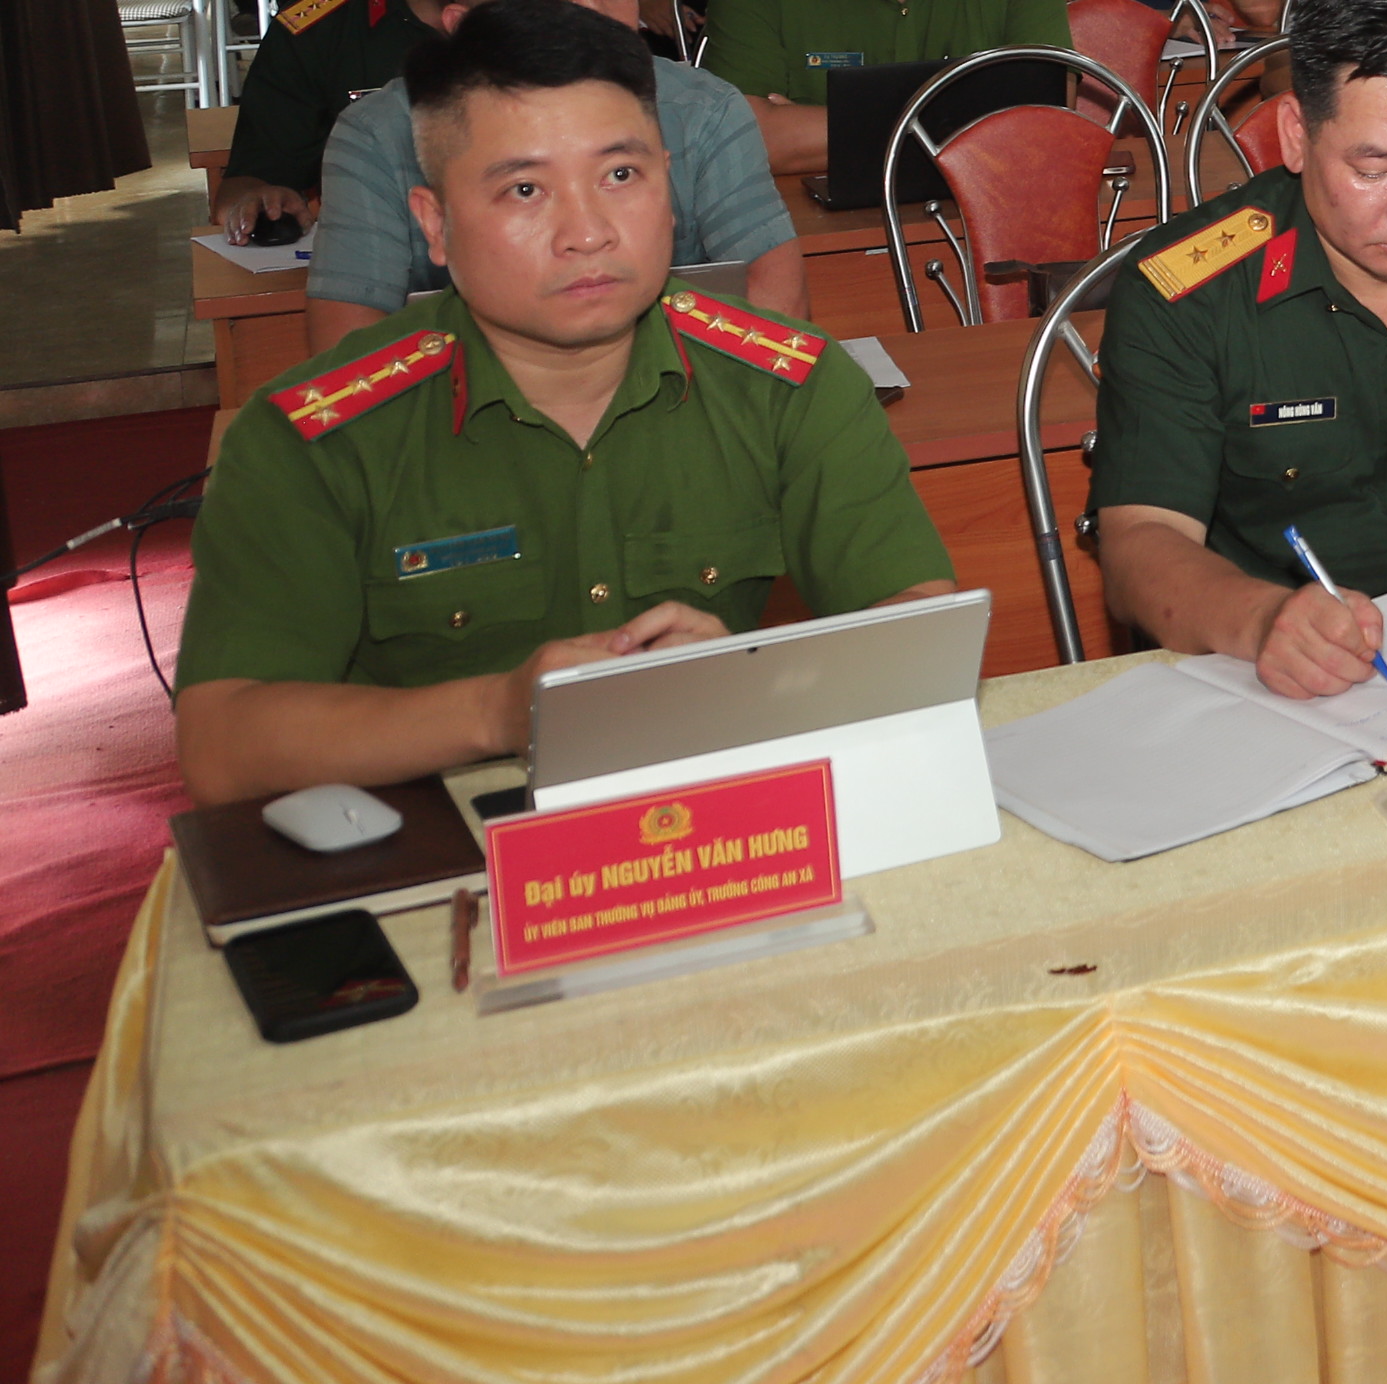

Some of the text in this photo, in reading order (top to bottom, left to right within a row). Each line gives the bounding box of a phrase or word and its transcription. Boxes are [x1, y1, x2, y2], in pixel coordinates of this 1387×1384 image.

[525, 825, 809, 908] Đại úy NGUYỄN VĂN HƯNG
[750, 874, 780, 894] CÔNG
[781, 869, 797, 887] AN
